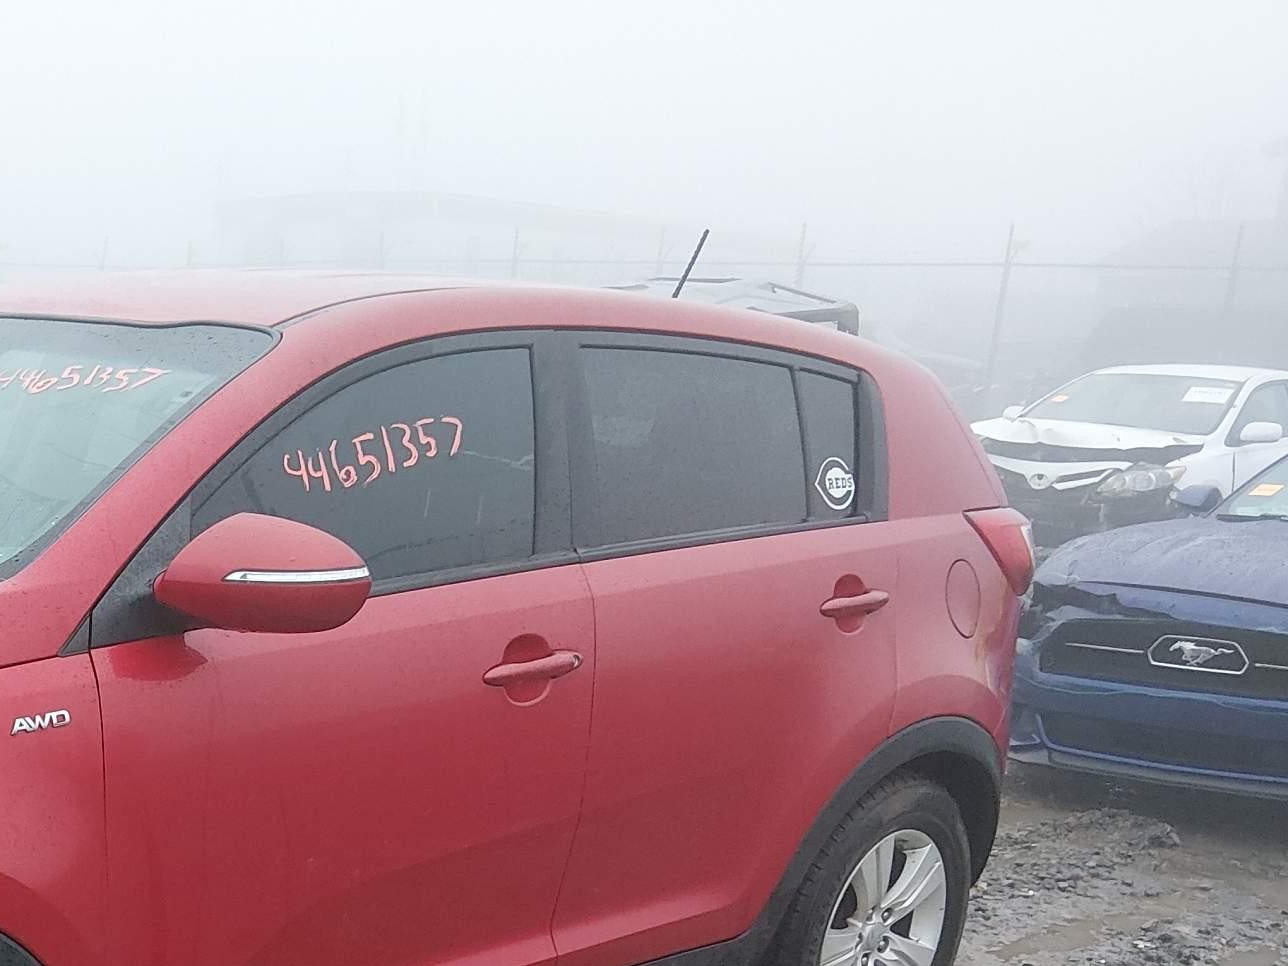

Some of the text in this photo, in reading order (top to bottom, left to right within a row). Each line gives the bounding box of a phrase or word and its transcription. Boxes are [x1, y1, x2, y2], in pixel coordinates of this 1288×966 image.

[283, 416, 463, 491] 44651357
[827, 477, 853, 490] REDS
[10, 709, 71, 735] AWD
